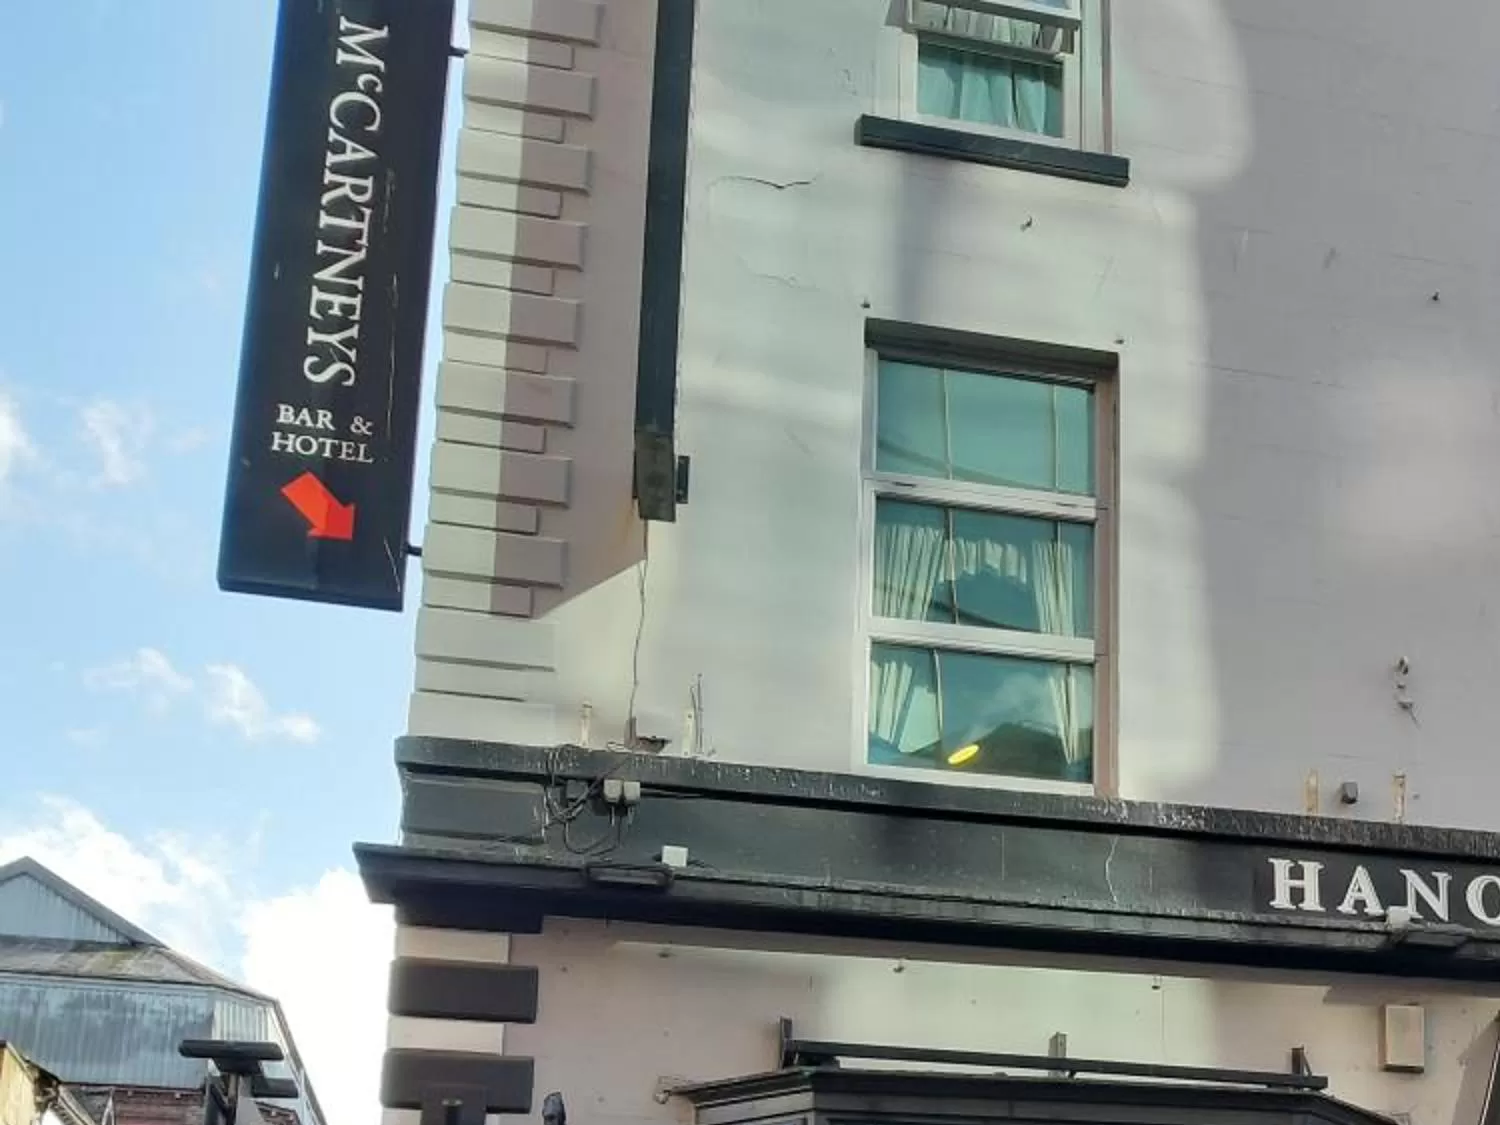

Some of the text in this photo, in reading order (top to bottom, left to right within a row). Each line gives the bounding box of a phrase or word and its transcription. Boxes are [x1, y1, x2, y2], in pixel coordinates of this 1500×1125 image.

[277, 404, 373, 435] BAR &
[271, 430, 373, 463] HOTEL
